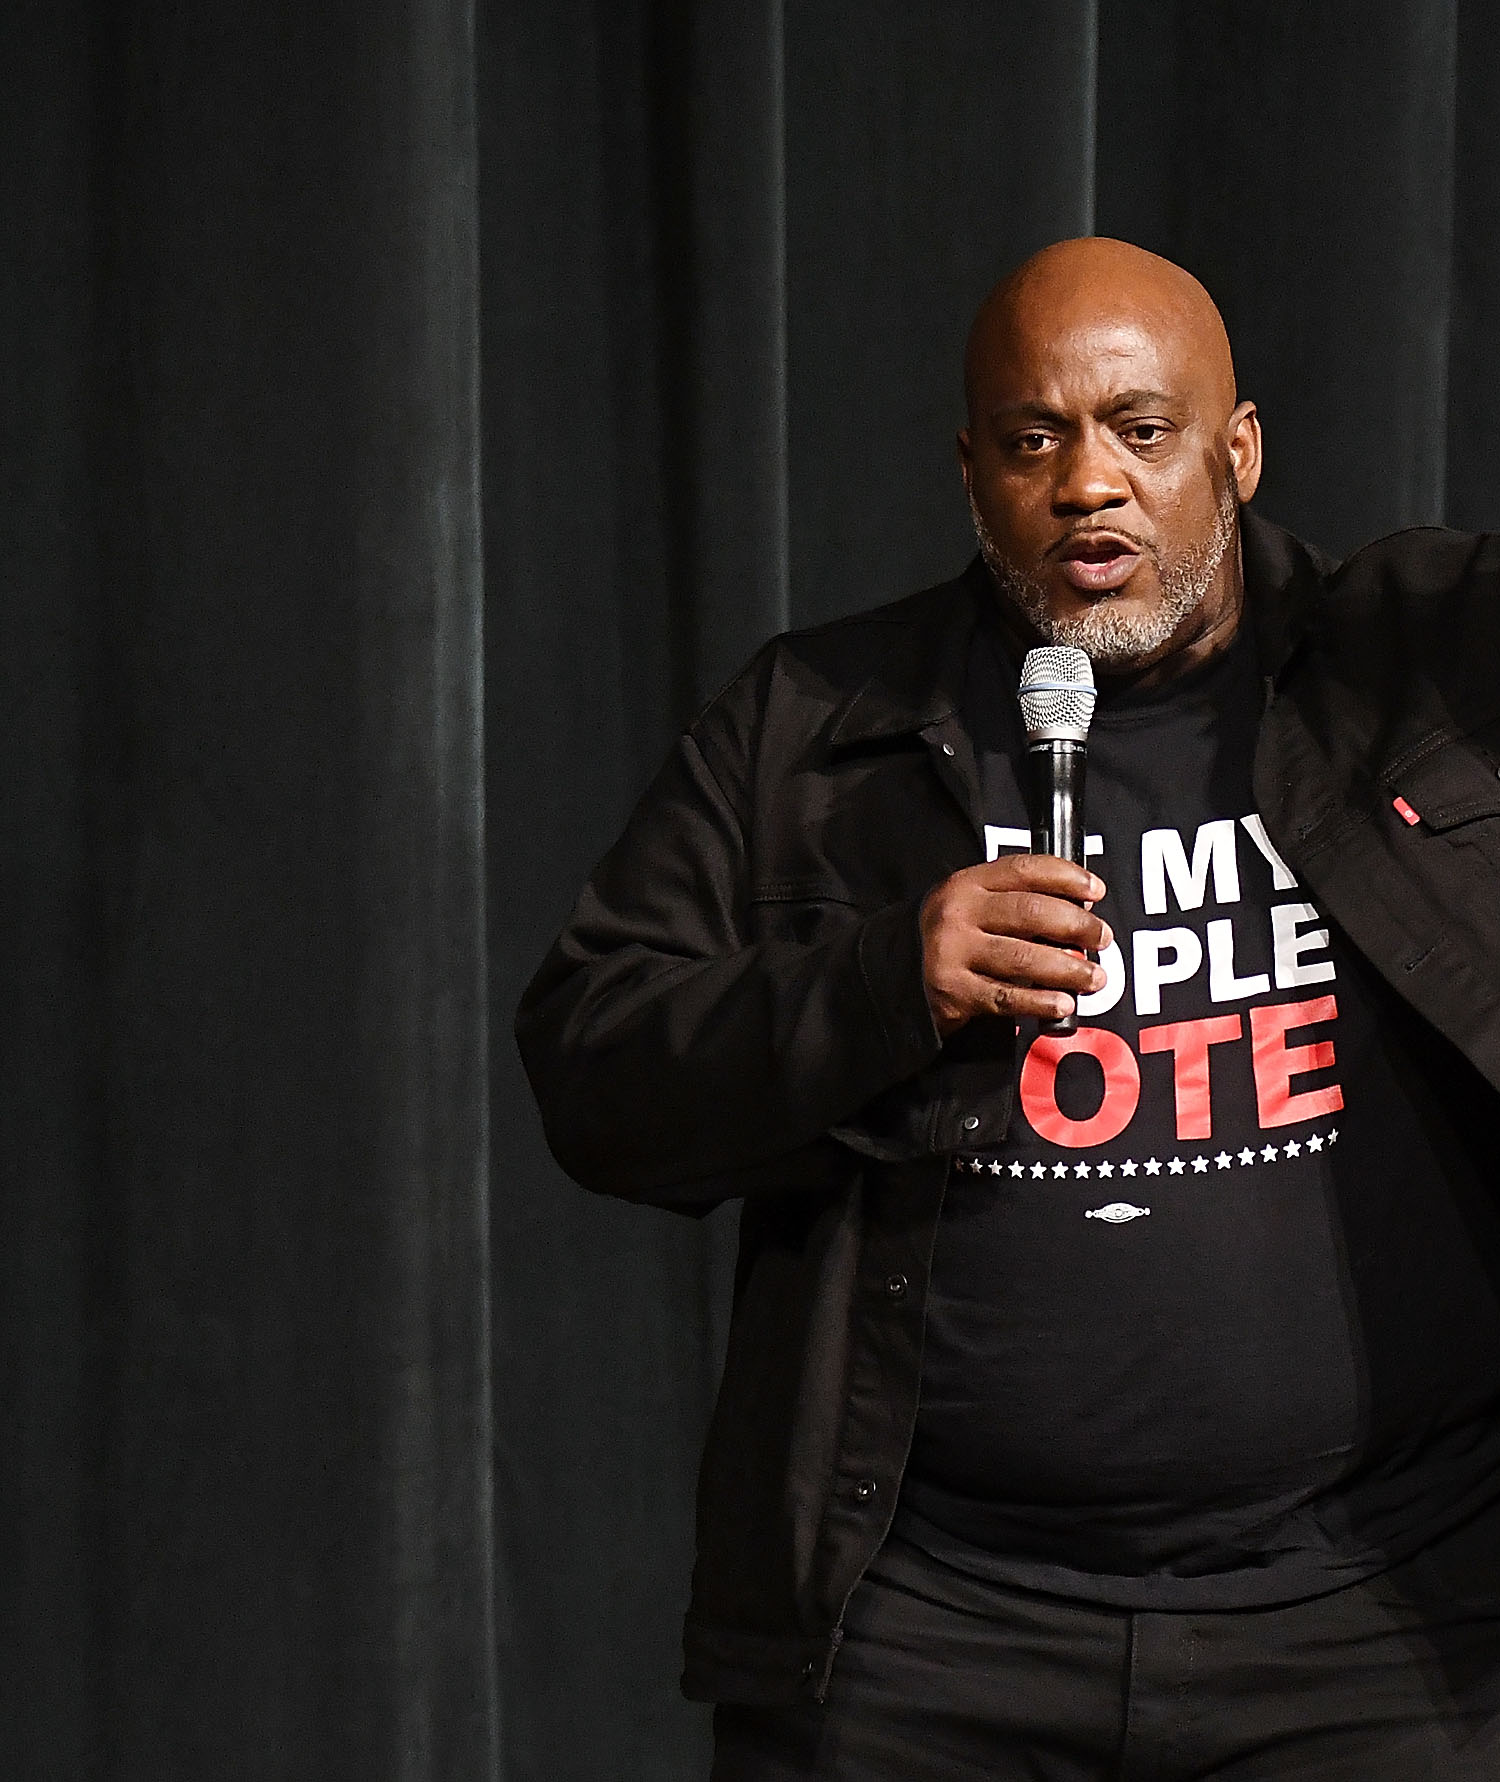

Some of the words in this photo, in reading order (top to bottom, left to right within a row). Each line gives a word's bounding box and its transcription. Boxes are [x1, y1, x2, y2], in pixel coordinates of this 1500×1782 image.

[1141, 813, 1299, 915] MY
[1077, 903, 1336, 1017] OPLE
[1016, 994, 1344, 1149] OTE
